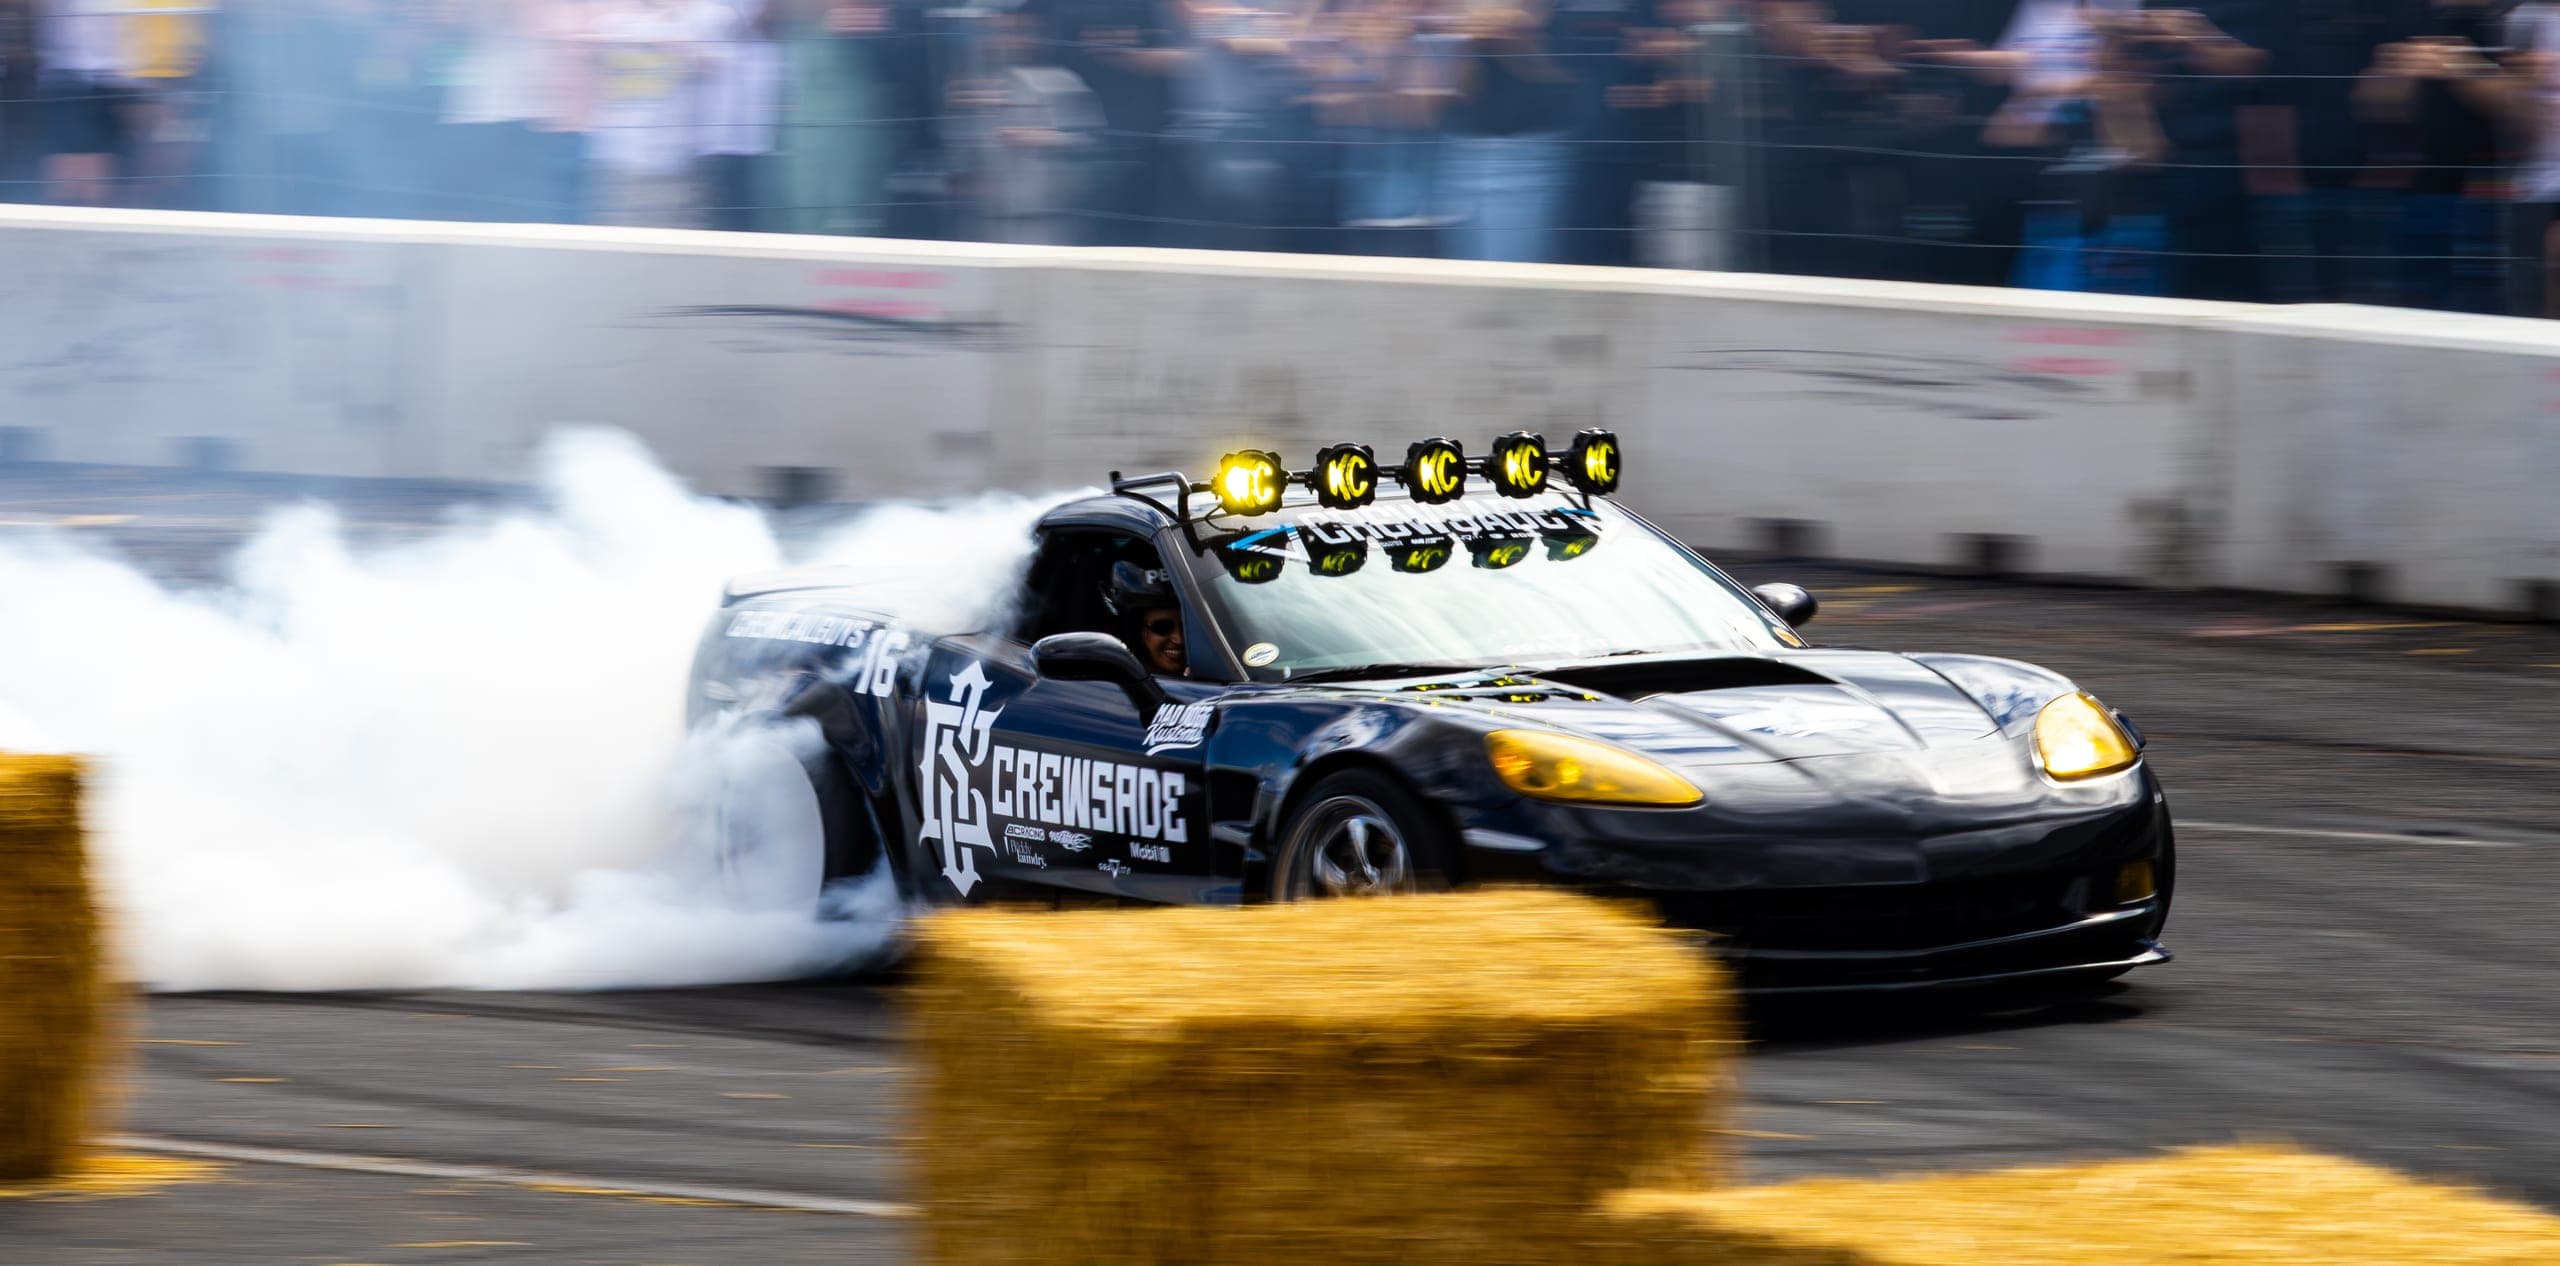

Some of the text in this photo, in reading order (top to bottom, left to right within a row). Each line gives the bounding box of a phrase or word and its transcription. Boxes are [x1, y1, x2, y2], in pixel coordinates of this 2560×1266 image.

[1226, 460, 1275, 507] KC
[1328, 454, 1369, 501] KC
[1420, 449, 1459, 496] KC
[1505, 443, 1543, 489] KC
[1585, 443, 1614, 485] KC
[853, 629, 911, 698] 16
[991, 744, 1189, 844] CREWSADE
